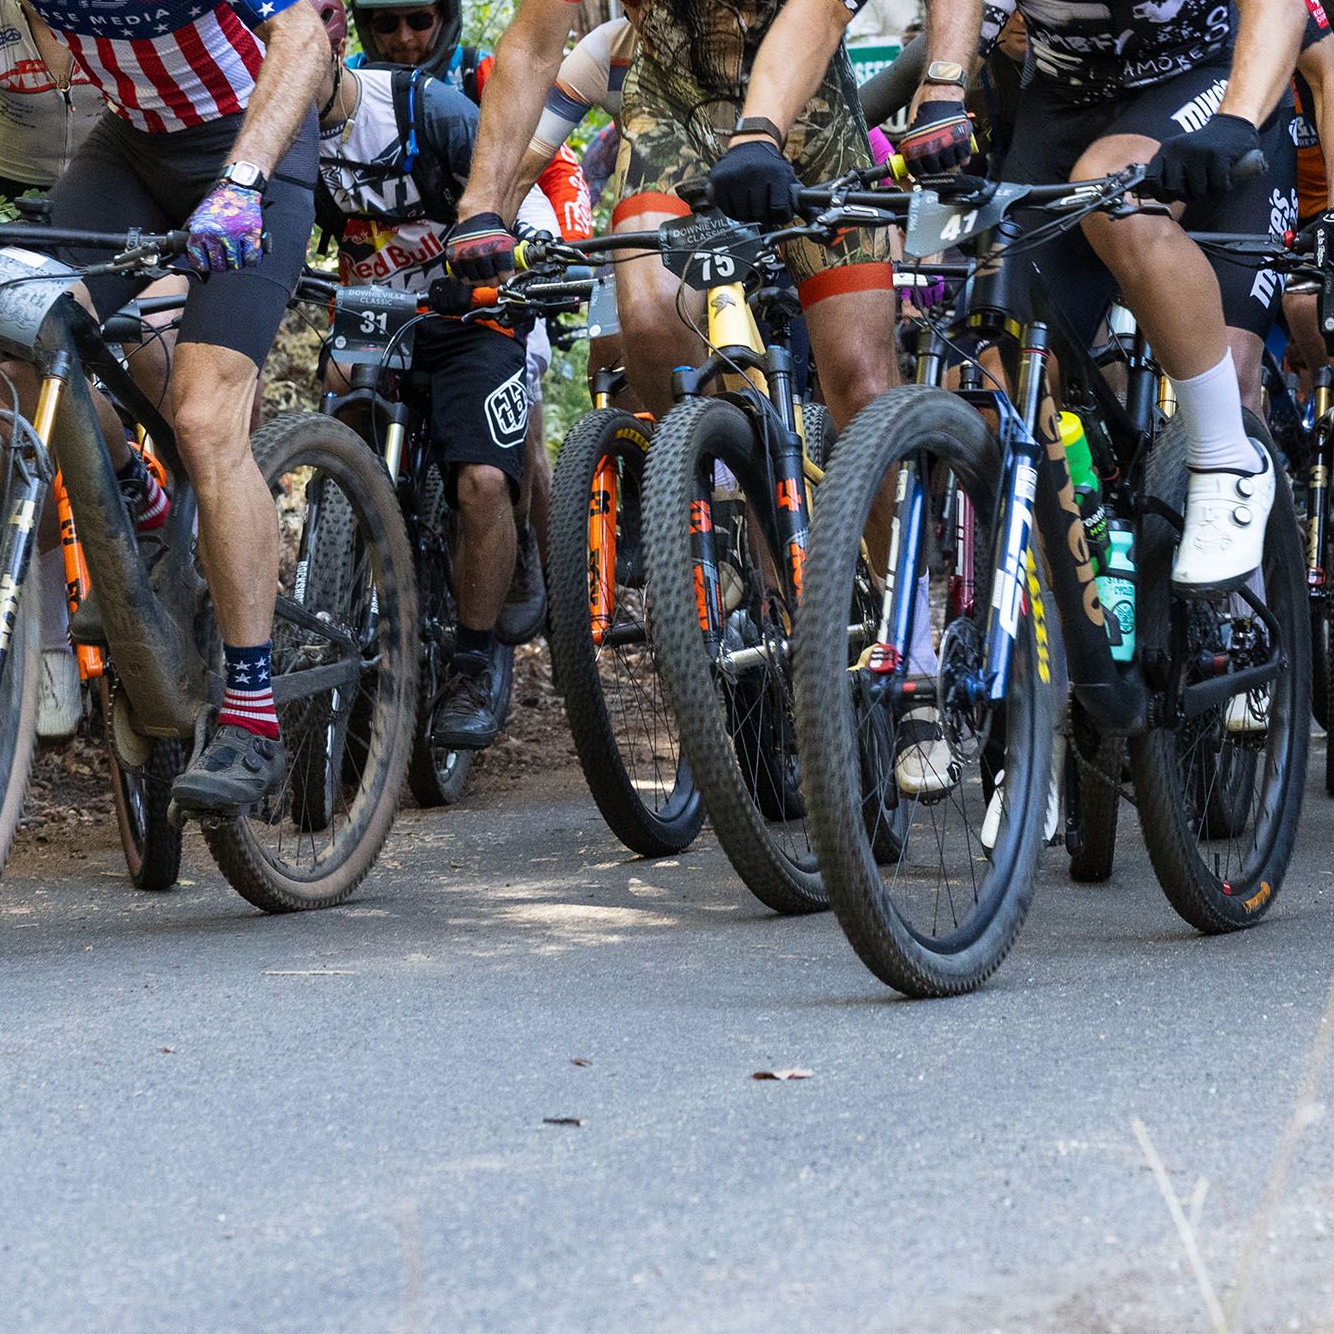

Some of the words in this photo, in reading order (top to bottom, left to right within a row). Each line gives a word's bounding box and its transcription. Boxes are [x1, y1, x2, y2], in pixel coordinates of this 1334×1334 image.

[90, 7, 171, 26] MEDIA
[940, 209, 979, 241] 41
[385, 231, 445, 271] Bull
[693, 245, 735, 282] 75
[359, 310, 388, 335] 31
